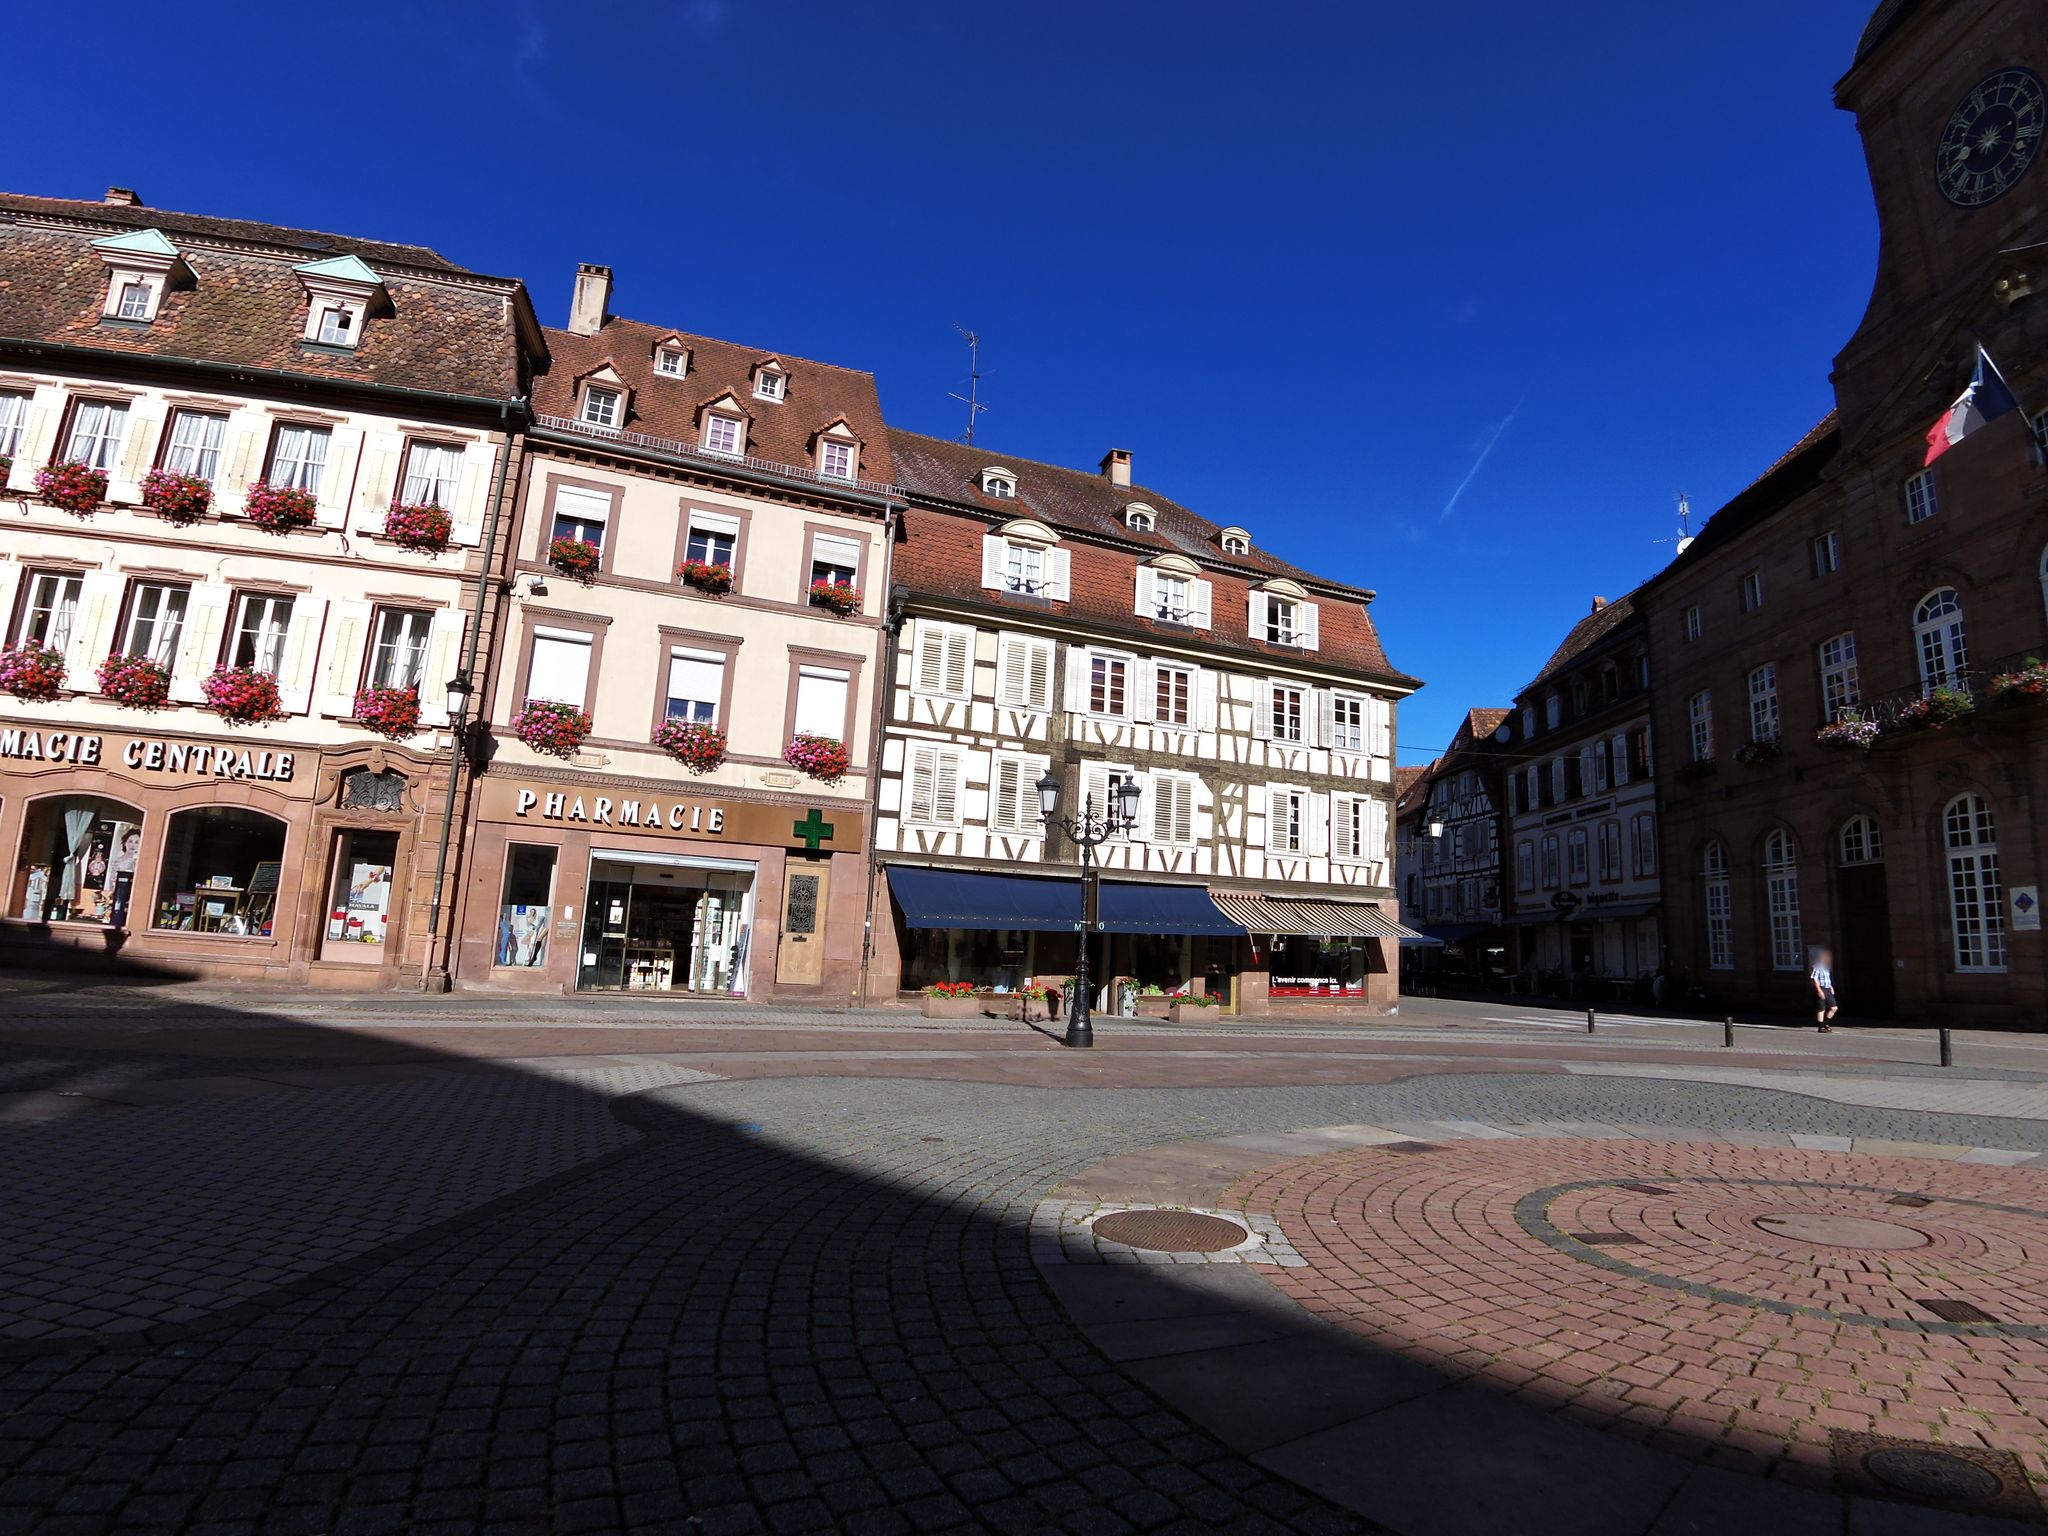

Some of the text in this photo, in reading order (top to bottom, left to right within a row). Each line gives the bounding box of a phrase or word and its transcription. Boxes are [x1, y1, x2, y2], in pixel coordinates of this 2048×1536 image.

[0, 729, 294, 780] MACIE CENTRALE
[516, 790, 724, 833] PHARMACIE
